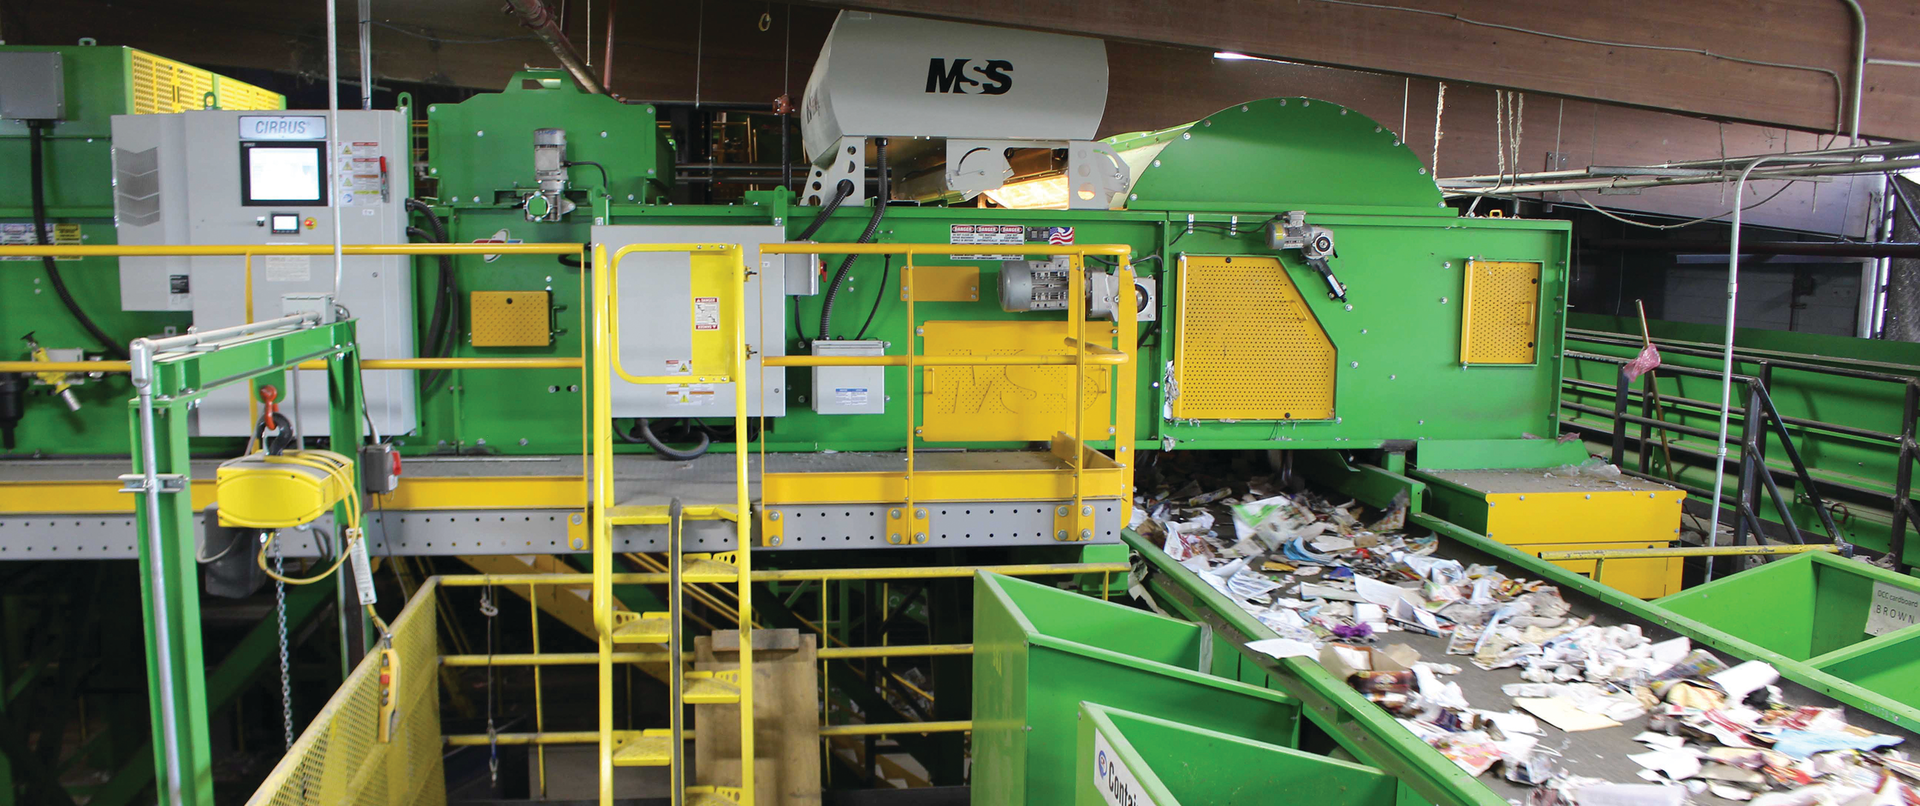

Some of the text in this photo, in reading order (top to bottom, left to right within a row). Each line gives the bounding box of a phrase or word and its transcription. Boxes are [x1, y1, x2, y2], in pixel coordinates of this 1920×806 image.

[925, 58, 1014, 95] MSS
[255, 120, 306, 134] CIRRUS
[1878, 590, 1918, 608] OCC cardboard
